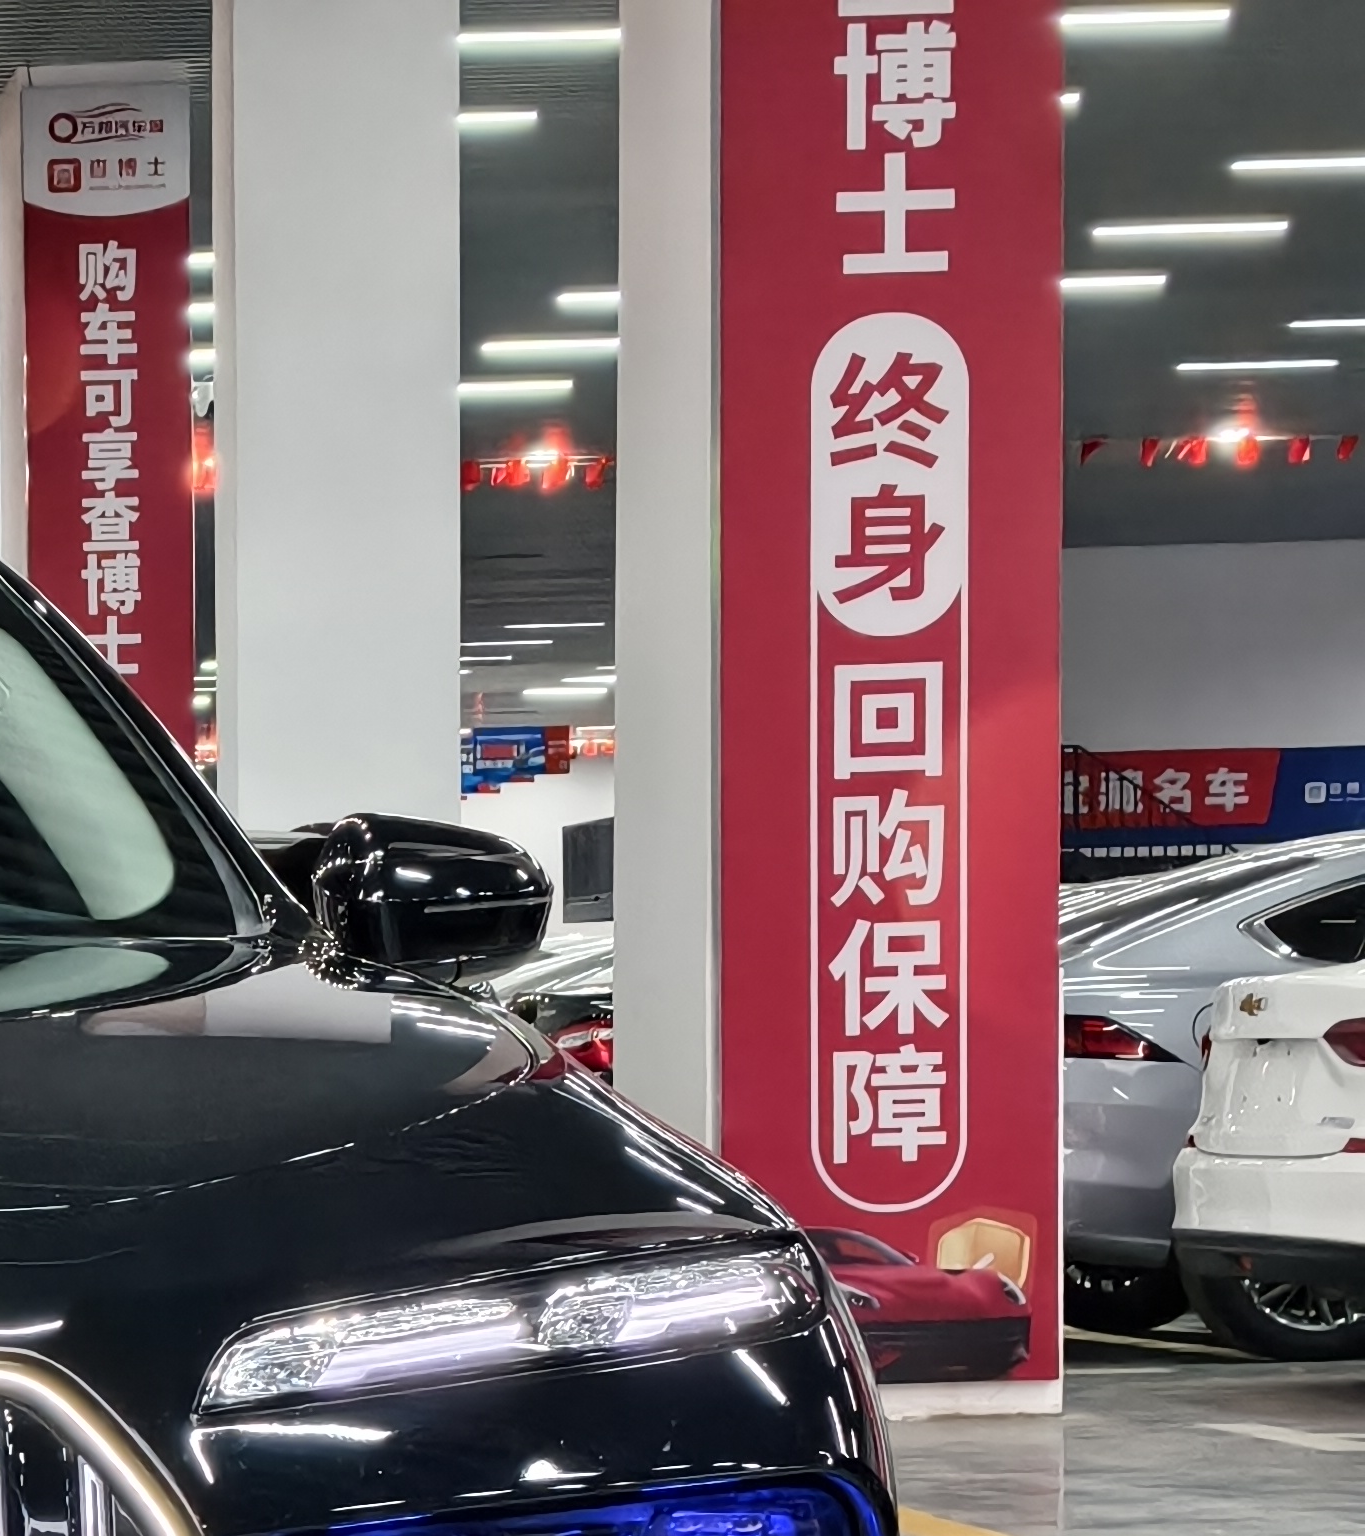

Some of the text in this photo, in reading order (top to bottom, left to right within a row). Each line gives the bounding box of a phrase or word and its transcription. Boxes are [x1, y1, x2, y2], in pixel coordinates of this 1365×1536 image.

[78, 240, 141, 675] 购车可享查博士
[829, 0, 956, 1164] 博士 终身 回购保障
